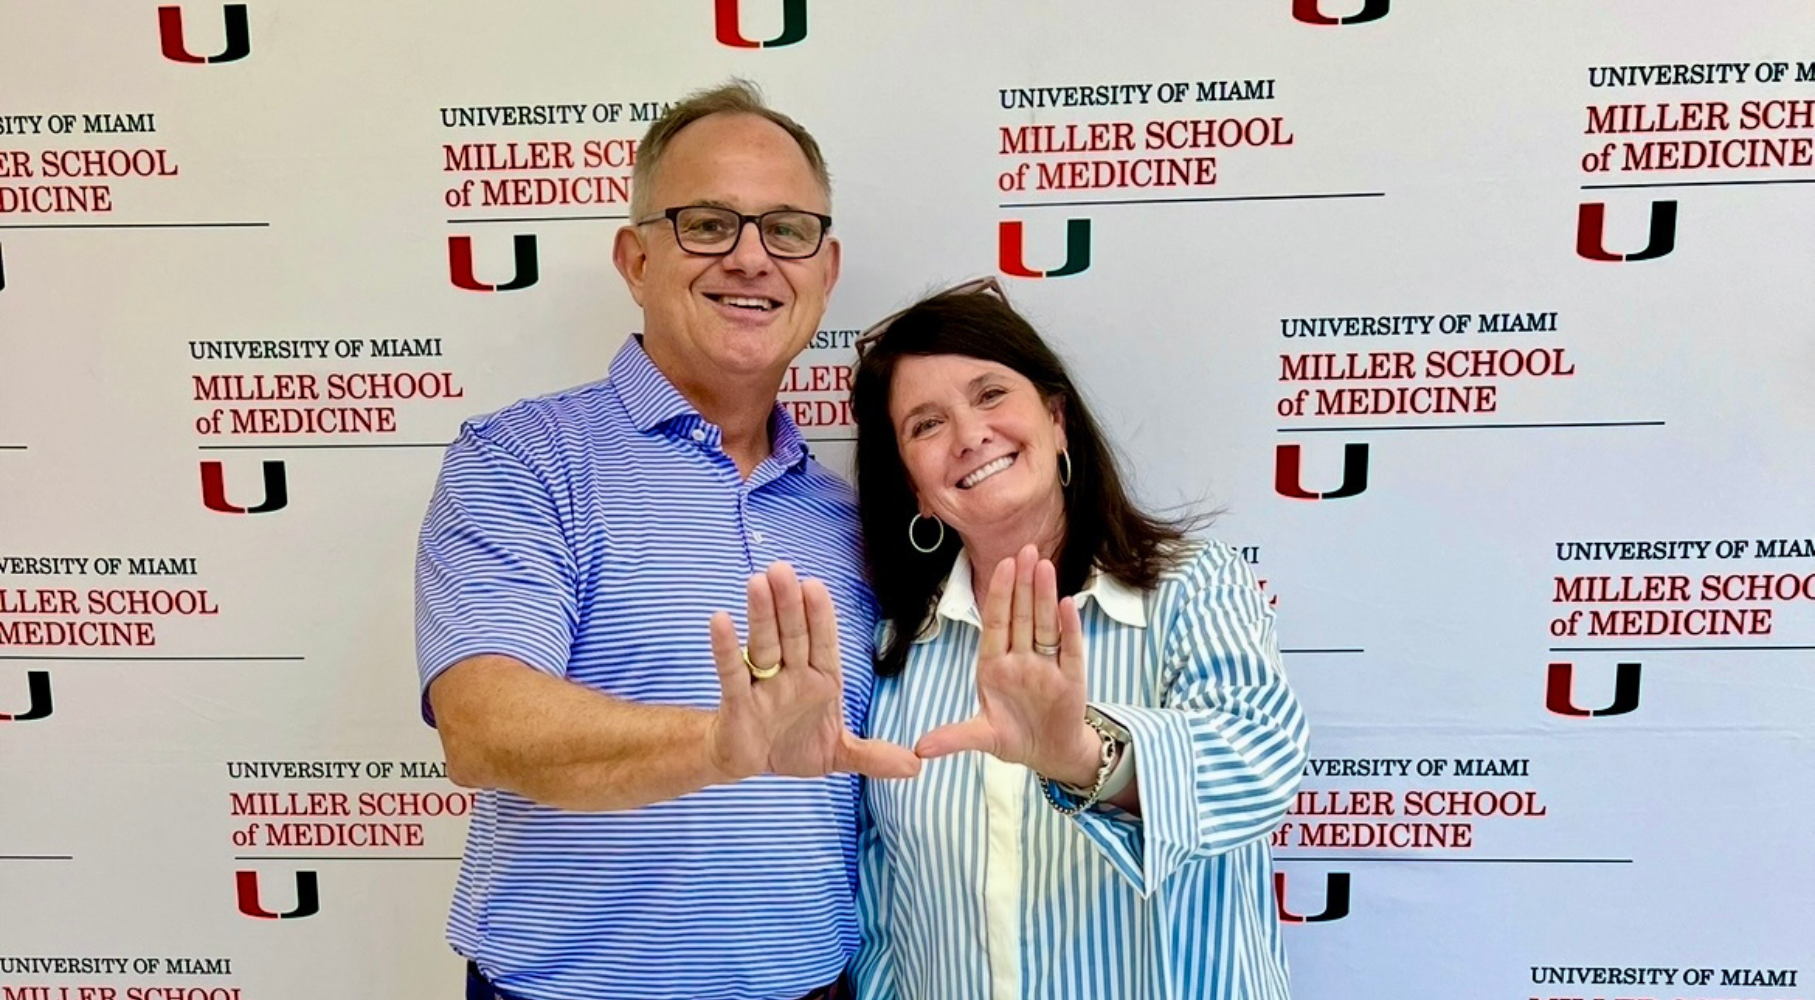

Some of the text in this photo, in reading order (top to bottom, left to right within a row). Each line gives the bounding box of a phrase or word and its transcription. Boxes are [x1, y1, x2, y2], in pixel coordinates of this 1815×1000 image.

[157, 3, 251, 64] U
[714, 0, 808, 49] U
[1588, 62, 1751, 88] UNIVERSITY
[1754, 62, 1790, 83] OF
[998, 79, 1276, 110] UNIVERSITY OF MIAMI
[47, 114, 77, 134] OF
[82, 113, 156, 134] MIAMI
[439, 104, 588, 128] UNIVERSITY
[592, 103, 623, 123] OF
[1583, 101, 1730, 135] MILLER
[998, 116, 1294, 155] MILLER SCHOOL
[41, 149, 178, 178] SCHOOL
[442, 141, 575, 172] MILLER
[1581, 137, 1813, 173] of MEDICINE
[998, 157, 1217, 192] of MEDICINE
[444, 176, 632, 208] of MEDICIN
[1575, 199, 1678, 263] U
[447, 234, 539, 292] U
[998, 218, 1092, 279] U
[1280, 312, 1559, 339] UNIVERSITY OF MIAMI
[188, 338, 443, 360] UNIVERSITY OF MIAMI
[1278, 348, 1575, 382] MILLER SCHOOL
[191, 371, 464, 401] MILLER SCHOOL
[1277, 385, 1497, 417] of MEDICINE
[195, 407, 397, 435] of MEDICINE
[1274, 442, 1370, 500] U
[199, 460, 288, 514] U
[1555, 540, 1712, 561] UNIVERSITY
[1715, 539, 1749, 559] OF
[93, 557, 122, 576] OF
[127, 557, 198, 576] MIAMI
[87, 589, 219, 615] SCHOOL
[1552, 575, 1692, 603] MILLER
[1550, 608, 1772, 637] of MEDICINE
[1545, 662, 1642, 718] U
[226, 761, 362, 779] UNIVERSITY
[365, 761, 394, 779] OF
[1416, 758, 1448, 777] OF
[1452, 759, 1530, 777] MIAMI
[229, 792, 351, 817] MILLER
[1285, 790, 1547, 817] ILLER SCHOOL
[232, 822, 424, 847] of MEDICINE
[1297, 822, 1472, 848] MEDICINE
[235, 870, 320, 919] U
[132, 958, 161, 975] OF
[164, 958, 232, 975] MIAMI
[1530, 966, 1798, 988] UNIVERSITY OF MIAMI
